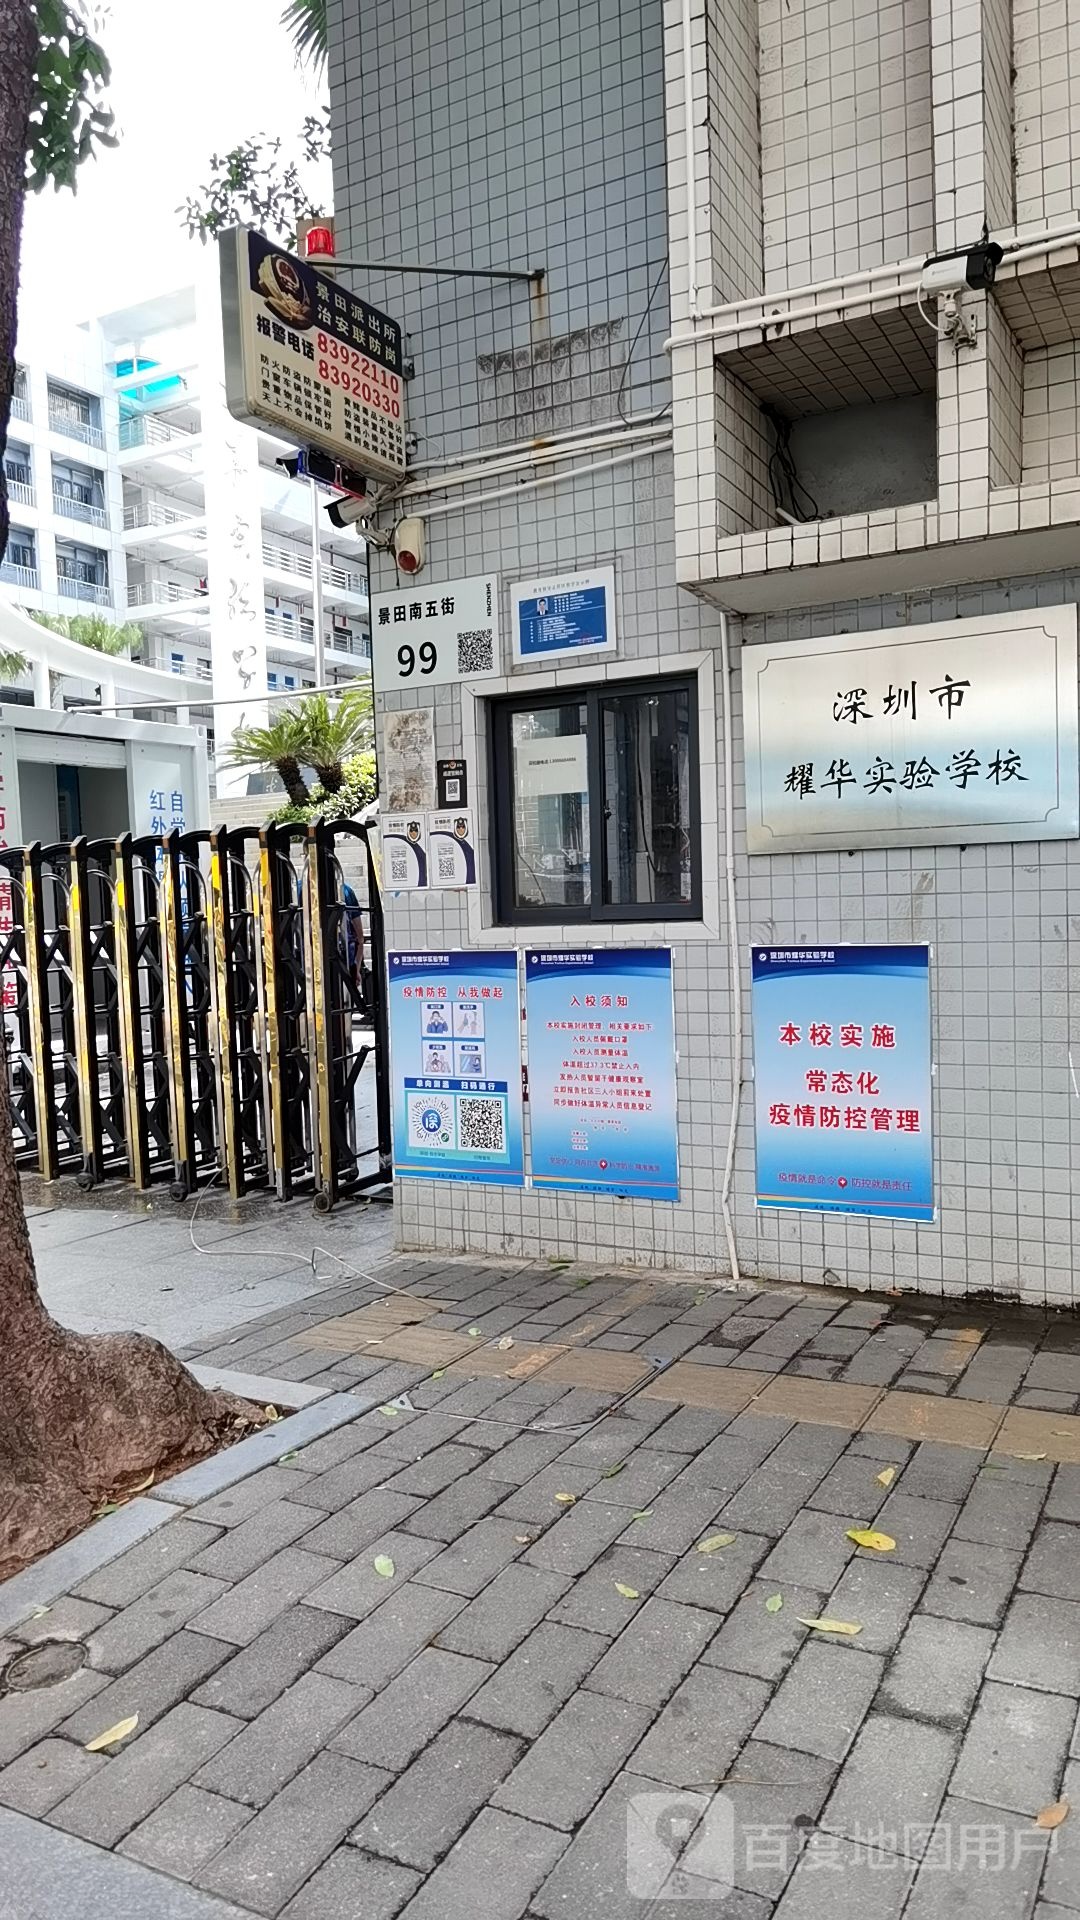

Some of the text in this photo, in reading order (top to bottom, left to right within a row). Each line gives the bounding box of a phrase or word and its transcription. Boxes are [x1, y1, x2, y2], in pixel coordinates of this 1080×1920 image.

[316, 281, 396, 344] 景田派出所
[256, 313, 399, 395] 报警电话 83922110
[317, 304, 396, 365] 治安联防岗
[261, 366, 332, 409] 门窗车辆锁牢固
[262, 379, 332, 420] 贵重物品保管好
[318, 358, 400, 418] 83920330
[262, 391, 332, 432] 天上不会掉馅饼
[378, 596, 455, 625] 景田南五街
[397, 641, 438, 677] 99
[832, 674, 971, 725] 深圳市
[784, 749, 1029, 800] 耀华实验学校
[403, 986, 503, 998] 疫情防控 从我做起
[570, 995, 629, 1008] 入校须知
[779, 1023, 896, 1048] 本校实施
[806, 1069, 880, 1095] 常态化
[769, 1103, 921, 1133] 疫情防控管理
[778, 1172, 913, 1191] 疫情就是命令 防控就是责任
